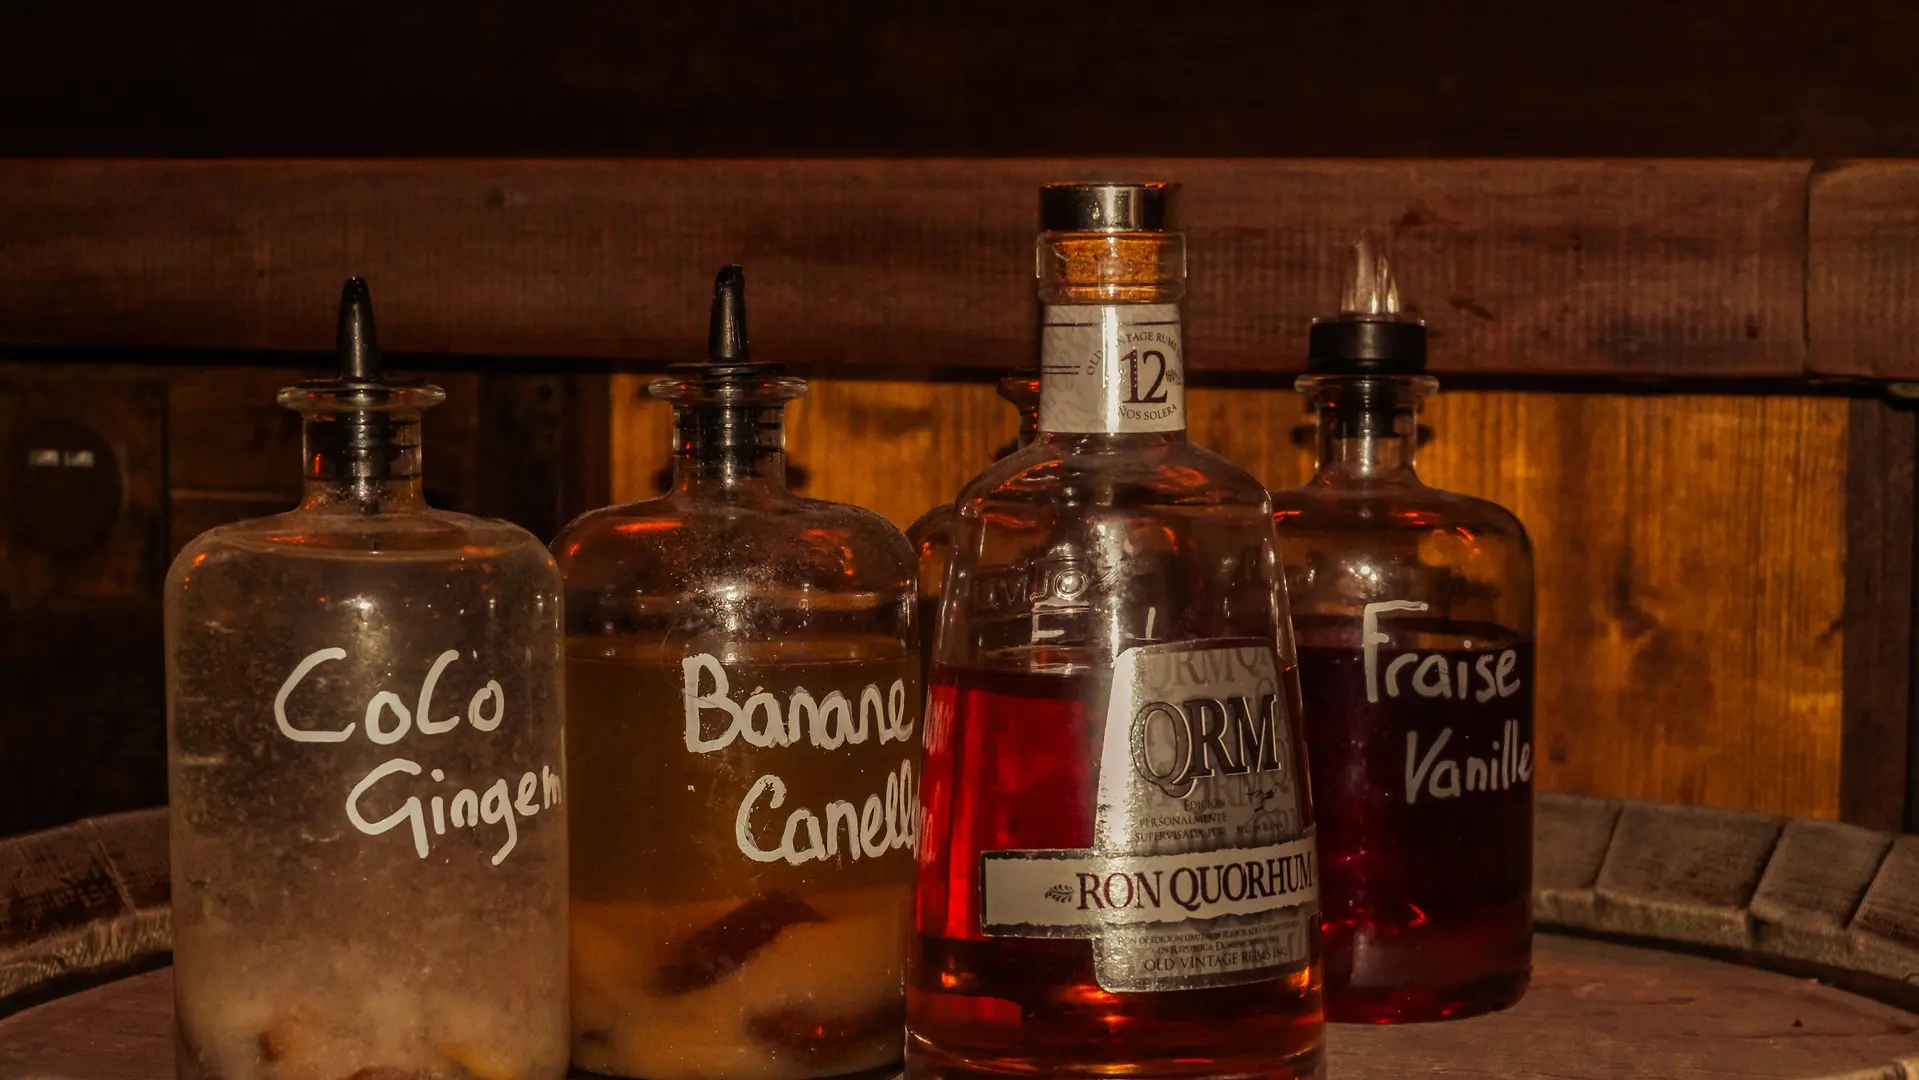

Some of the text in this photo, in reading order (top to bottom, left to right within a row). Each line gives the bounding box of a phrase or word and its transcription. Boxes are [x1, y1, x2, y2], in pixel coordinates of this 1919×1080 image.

[1086, 350, 1104, 376] OLD
[1120, 349, 1168, 404] 12
[1143, 403, 1178, 421] SOLERA
[1363, 600, 1520, 703] Fraise
[682, 652, 915, 753] Banane
[1130, 694, 1282, 799] QRM
[1405, 719, 1533, 804] Vanille
[1134, 829, 1205, 843] SUPERVISADA
[1139, 812, 1229, 828] PERSONALMENTE
[1076, 851, 1314, 912] RON QUORHUM
[1144, 958, 1175, 972] OLD
[1180, 953, 1238, 969] VINTAGE
[1241, 950, 1271, 963] RUMS
